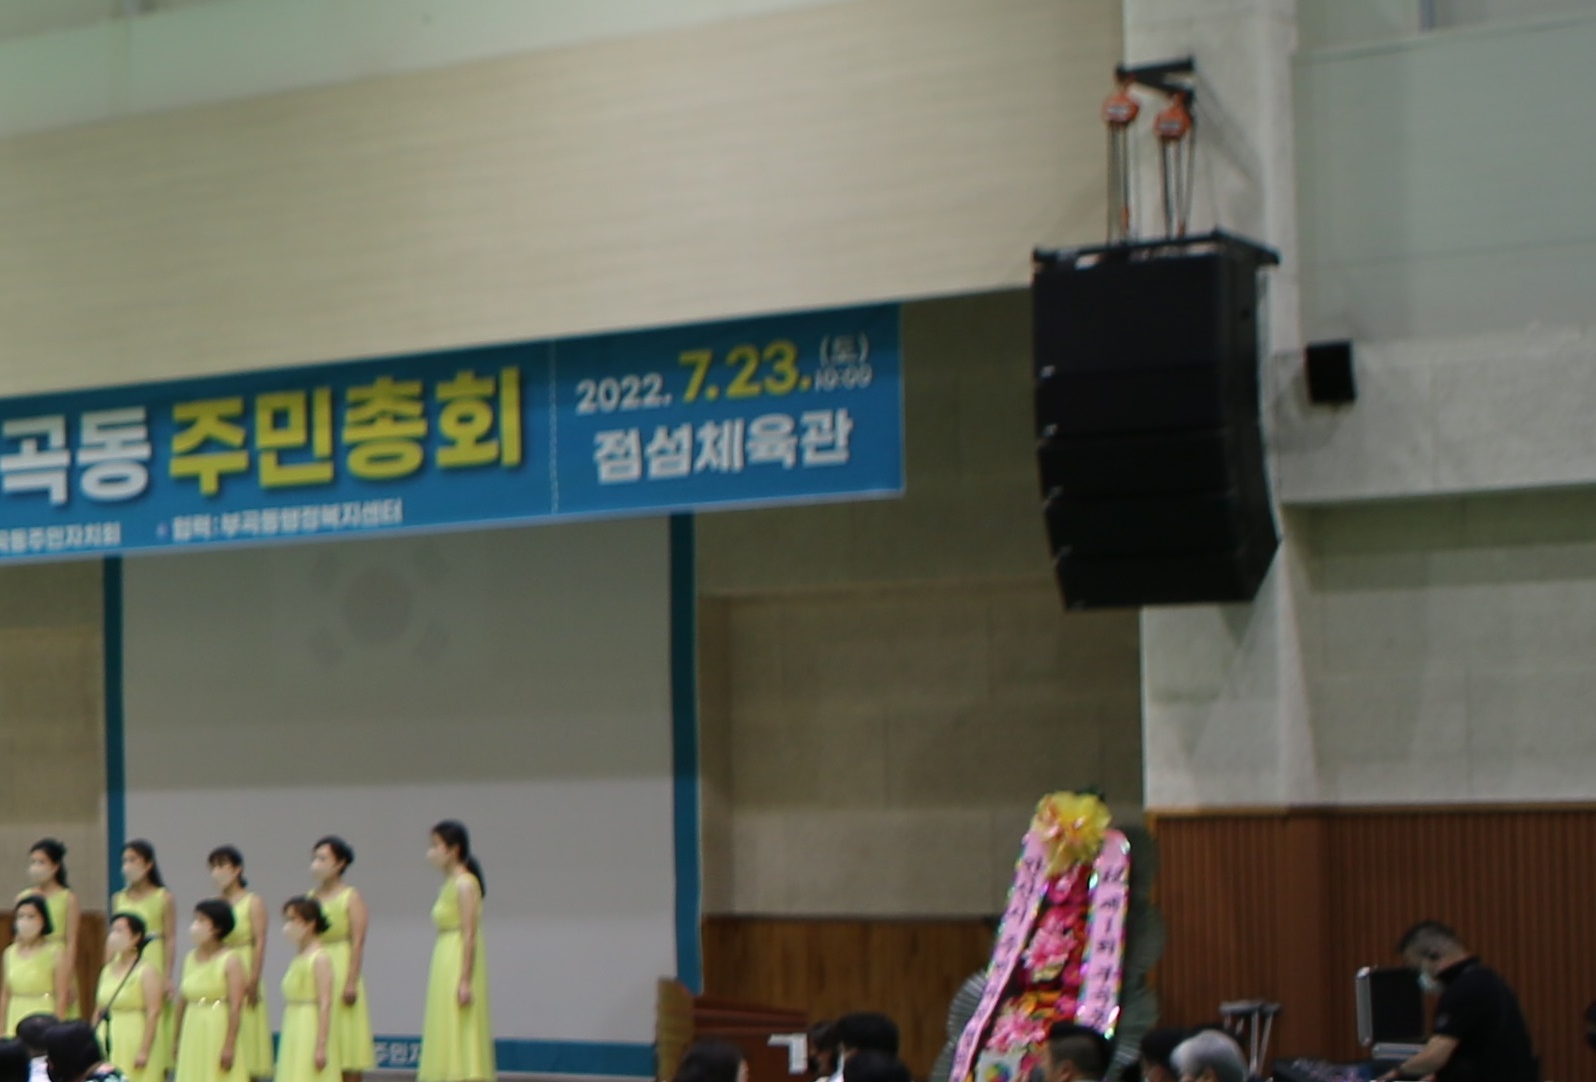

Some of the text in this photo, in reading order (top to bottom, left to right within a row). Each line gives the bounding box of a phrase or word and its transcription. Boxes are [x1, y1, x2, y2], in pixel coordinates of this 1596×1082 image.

[576, 339, 812, 416] 2022. 7.23.
[169, 366, 523, 496] 주민총회
[593, 407, 853, 486] 점섬체육관
